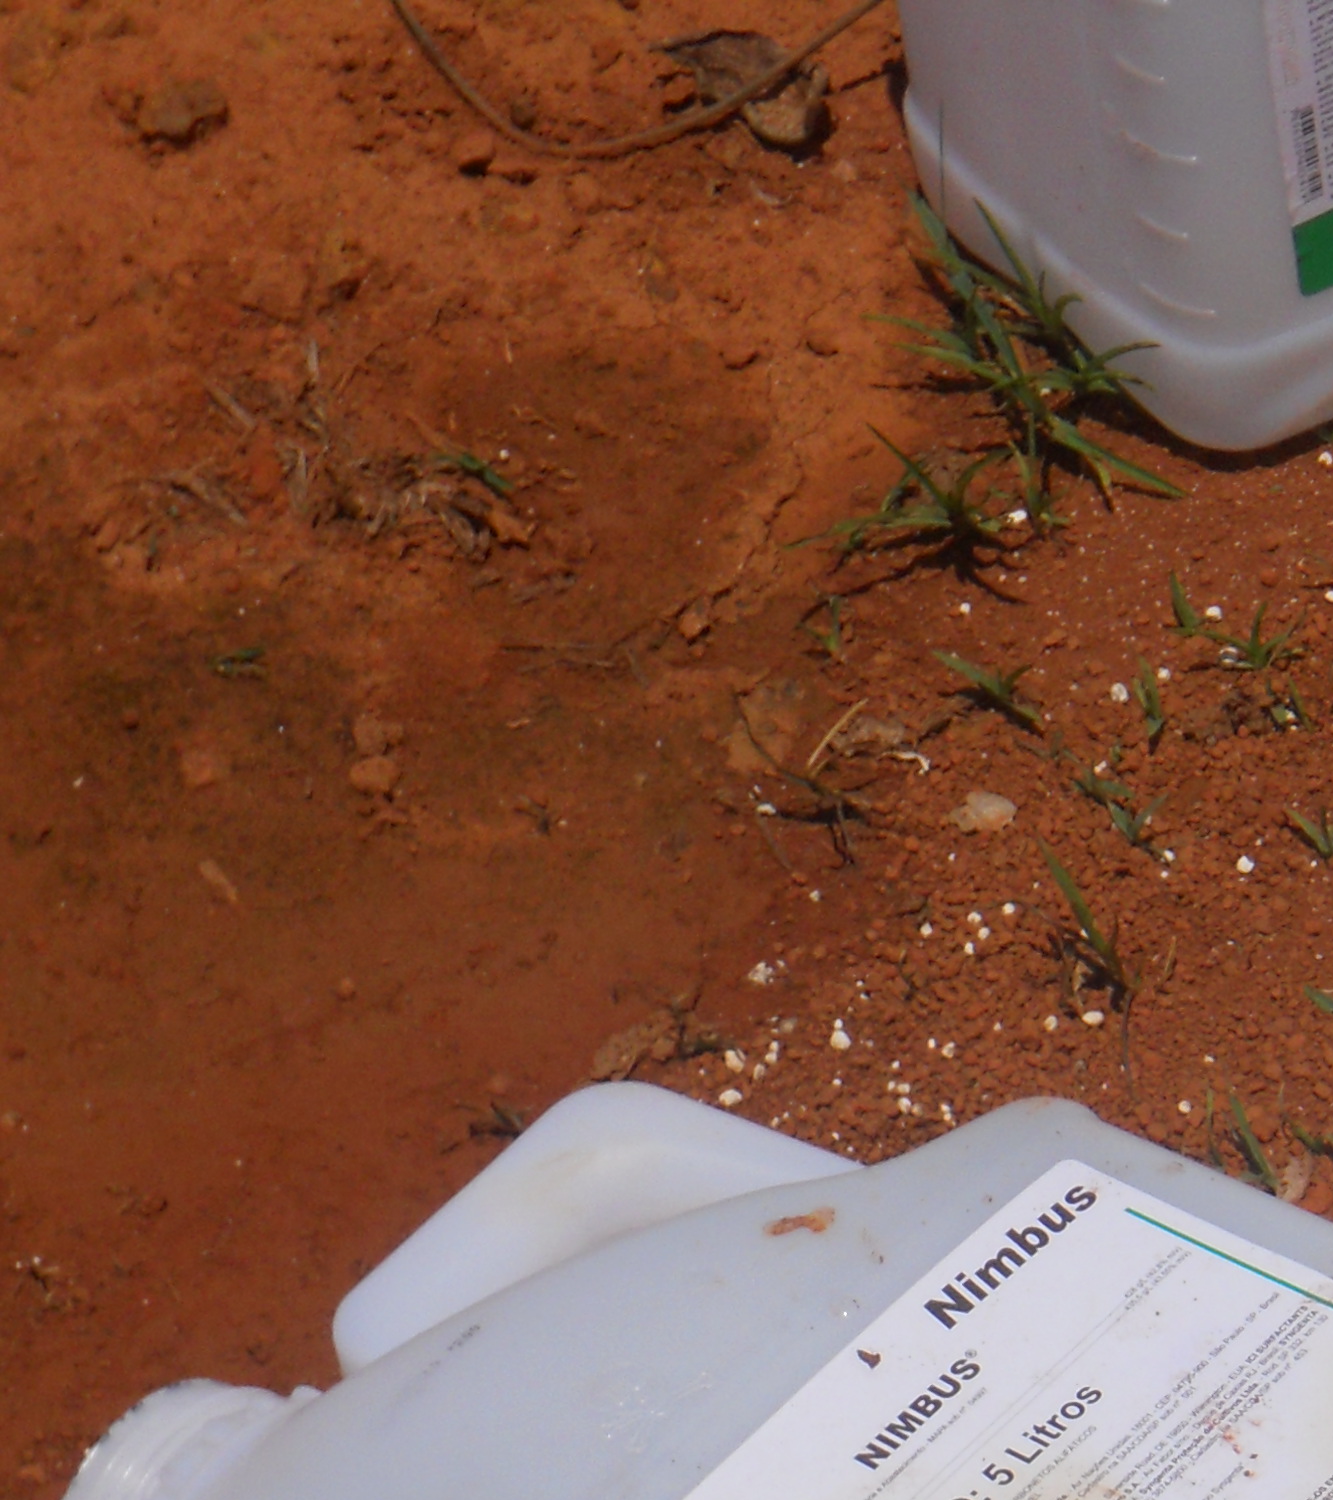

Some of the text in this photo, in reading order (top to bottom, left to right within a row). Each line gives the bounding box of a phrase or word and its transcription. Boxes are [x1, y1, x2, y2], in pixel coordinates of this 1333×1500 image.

[921, 1183, 1099, 1330] Nimbus
[980, 1462, 1017, 1487] 5
[1003, 1384, 1104, 1465] Litros
